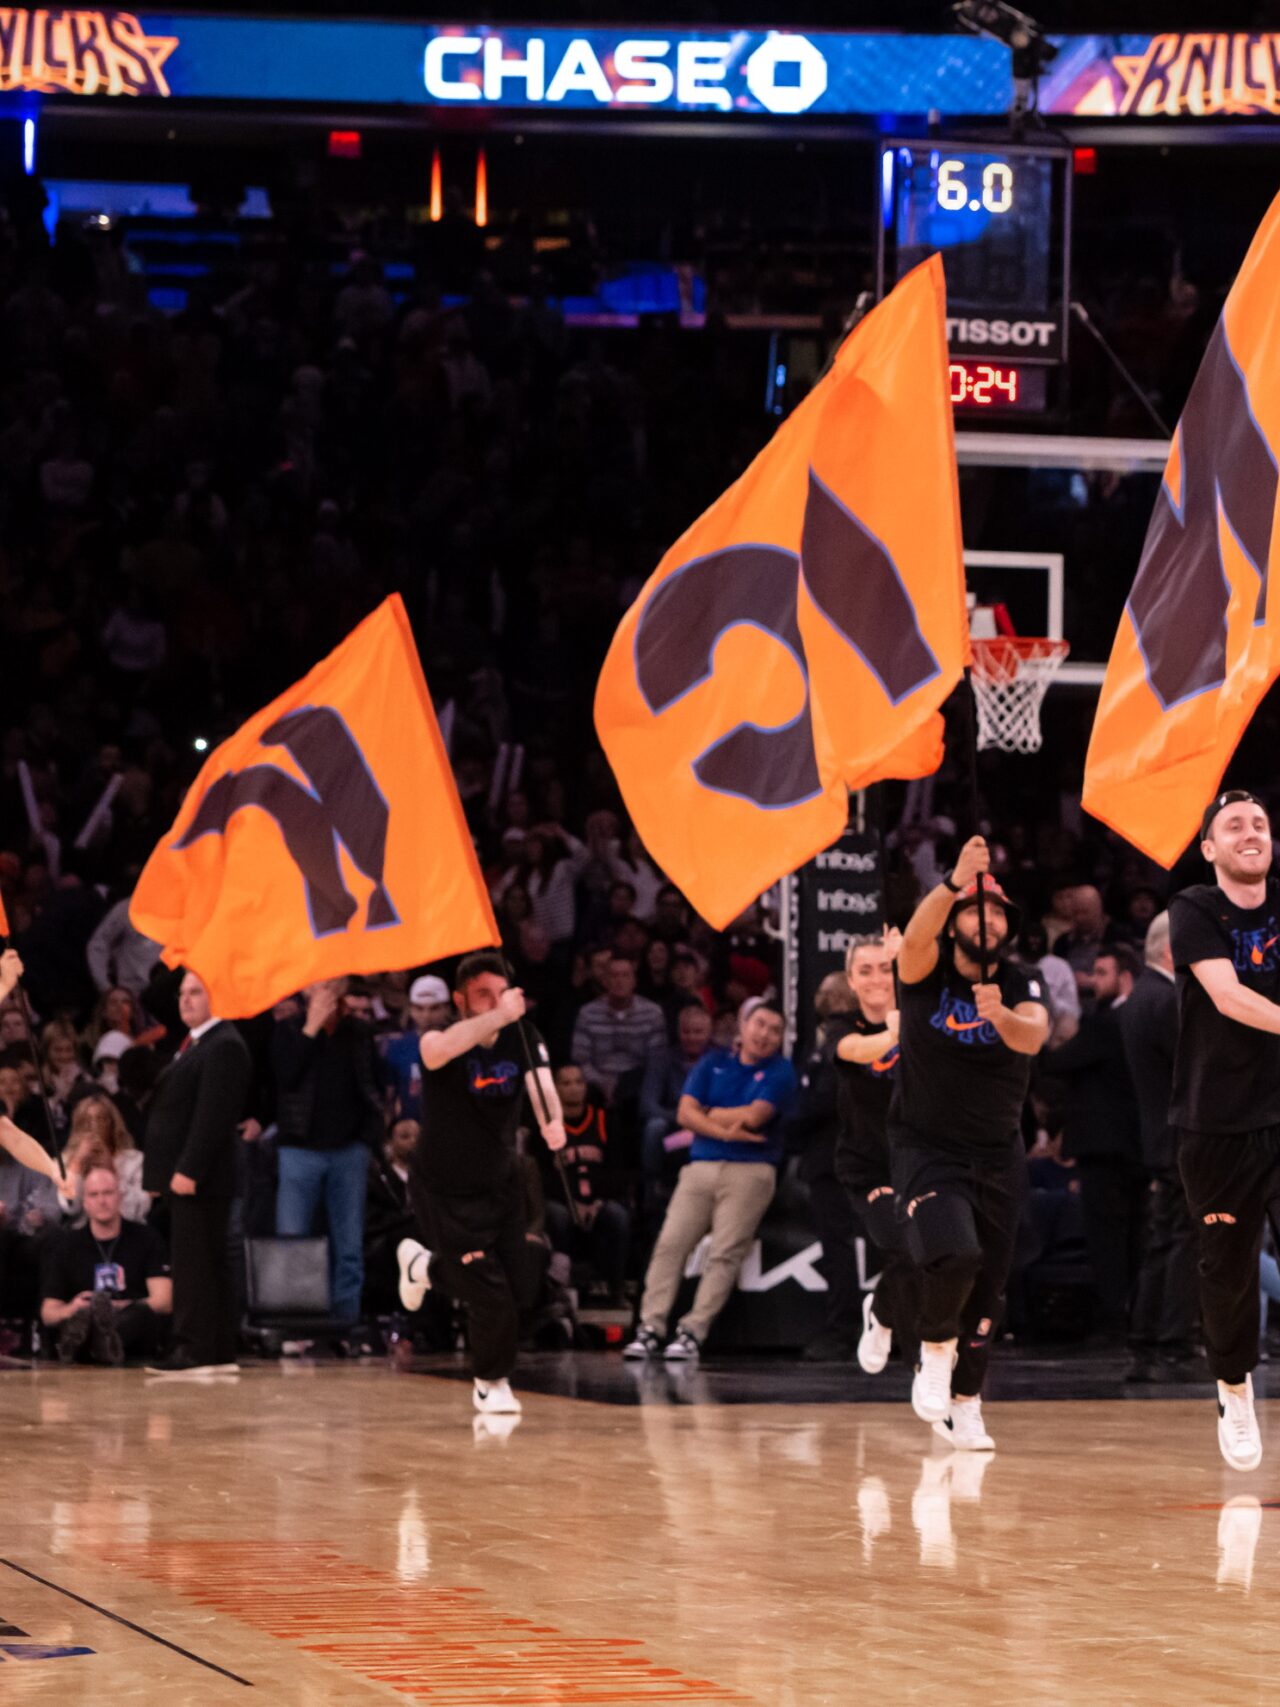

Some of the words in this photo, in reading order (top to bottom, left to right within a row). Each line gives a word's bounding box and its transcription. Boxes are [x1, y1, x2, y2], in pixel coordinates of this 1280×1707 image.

[424, 36, 733, 111] CHASE
[937, 161, 1013, 213] 6.0
[946, 318, 1056, 346] TISSOT
